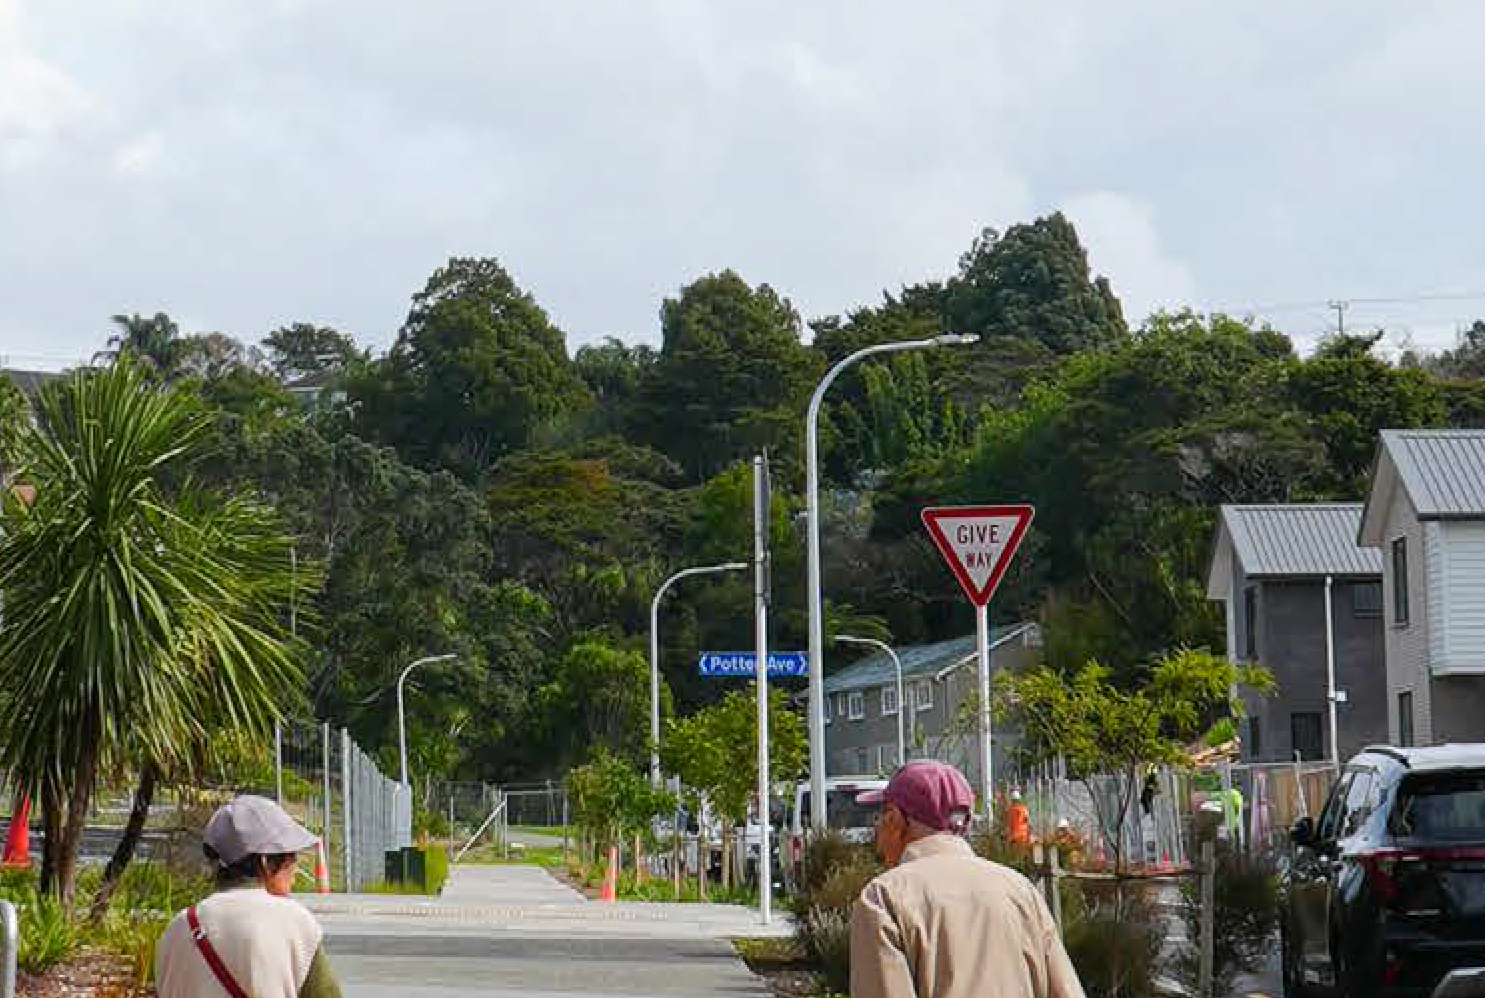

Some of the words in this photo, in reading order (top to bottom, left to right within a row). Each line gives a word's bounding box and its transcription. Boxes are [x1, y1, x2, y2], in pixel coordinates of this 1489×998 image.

[956, 524, 1000, 544] GIVE
[965, 552, 993, 568] WAY
[710, 656, 757, 671] Potte
[767, 656, 794, 671] Ave
